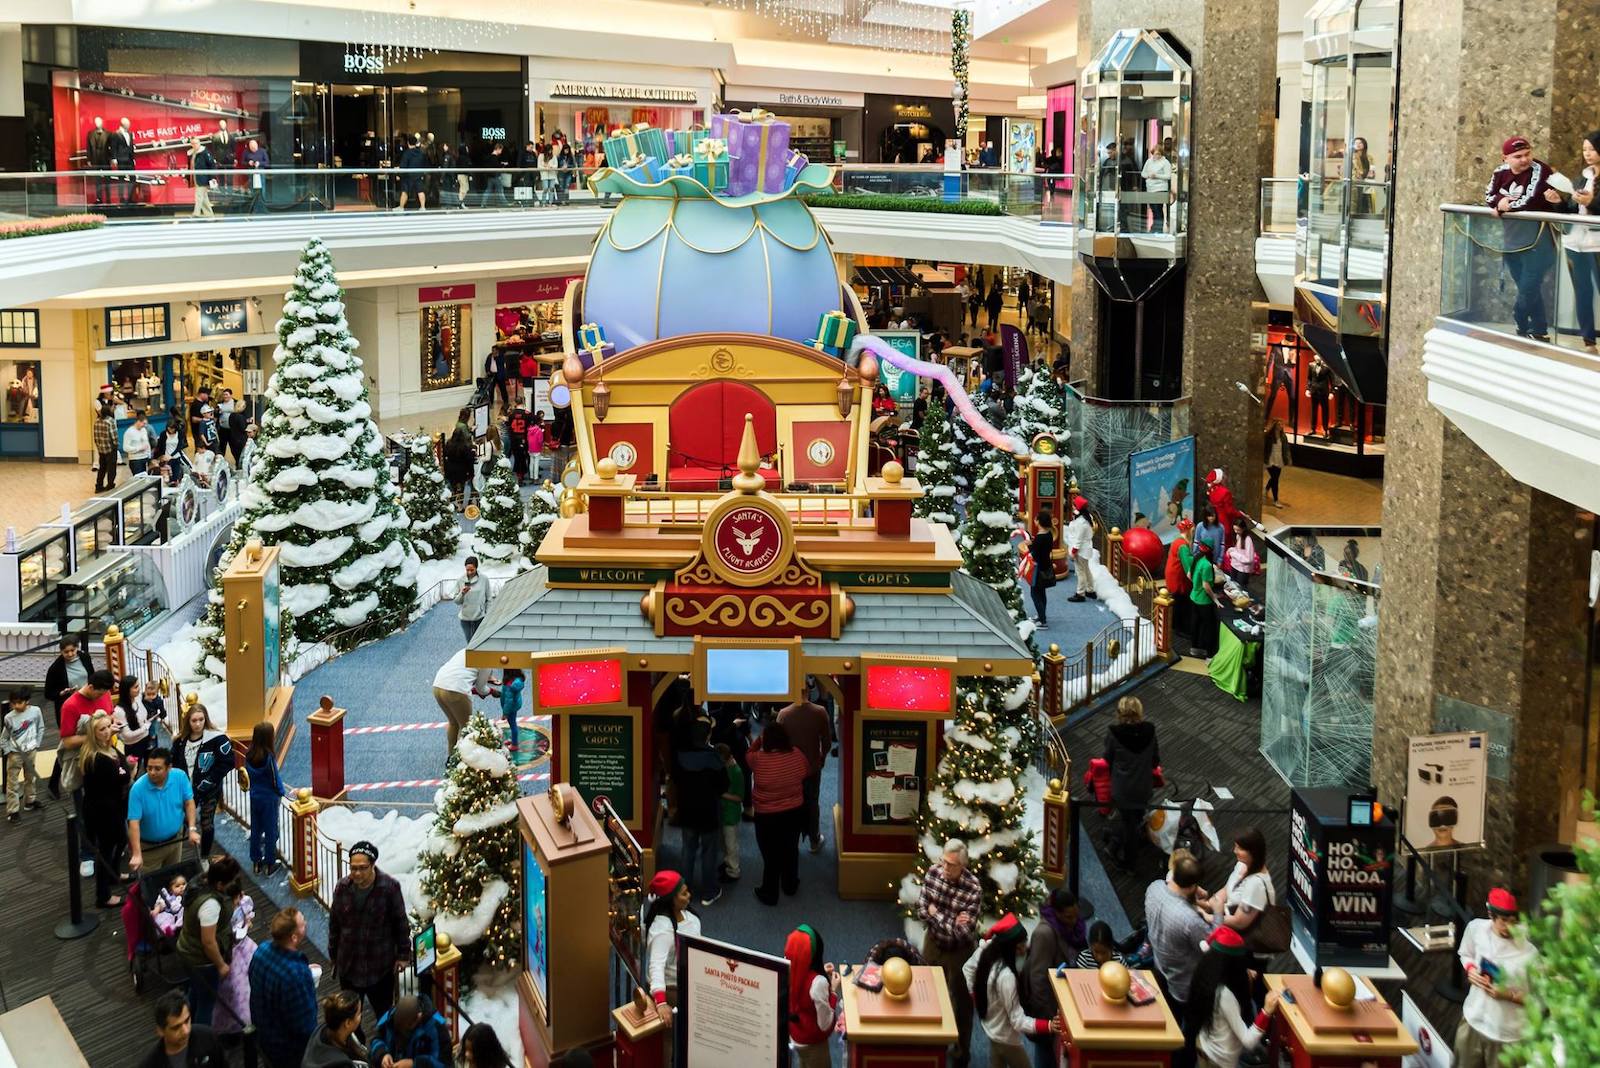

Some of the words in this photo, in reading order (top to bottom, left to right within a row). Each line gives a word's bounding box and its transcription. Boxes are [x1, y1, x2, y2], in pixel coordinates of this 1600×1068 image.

[344, 54, 384, 70] BOSS
[190, 88, 233, 104] HOLIDAY
[554, 84, 606, 96] AMERICAN
[611, 87, 640, 98] EAGLE
[644, 89, 697, 101] OUTFITTERS
[779, 93, 797, 103] Bath
[803, 95, 821, 106] Body
[821, 96, 843, 105] Works
[137, 130, 155, 138] THE
[157, 126, 178, 137] FAST
[180, 123, 202, 134] LANE
[482, 127, 505, 137] BOSS
[205, 304, 241, 314] JANIE
[208, 321, 240, 331] JACK
[512, 419, 525, 433] 42
[732, 511, 764, 523] SANTA'S
[722, 547, 745, 567] FLIGHT
[744, 547, 774, 568] ACADEMY
[580, 570, 646, 581] WELCOME
[858, 573, 911, 585] CADETS
[581, 724, 623, 733] WELCOME
[585, 736, 619, 744] CADETS
[1327, 856, 1358, 871] HO.
[1292, 860, 1312, 900] WIN
[1327, 870, 1386, 884] WHOA.
[1332, 896, 1377, 913] WIN
[704, 966, 720, 978] SANTA
[720, 971, 737, 982] PHOTO
[736, 975, 760, 990] PACKAGE
[720, 979, 744, 994] Pricing
